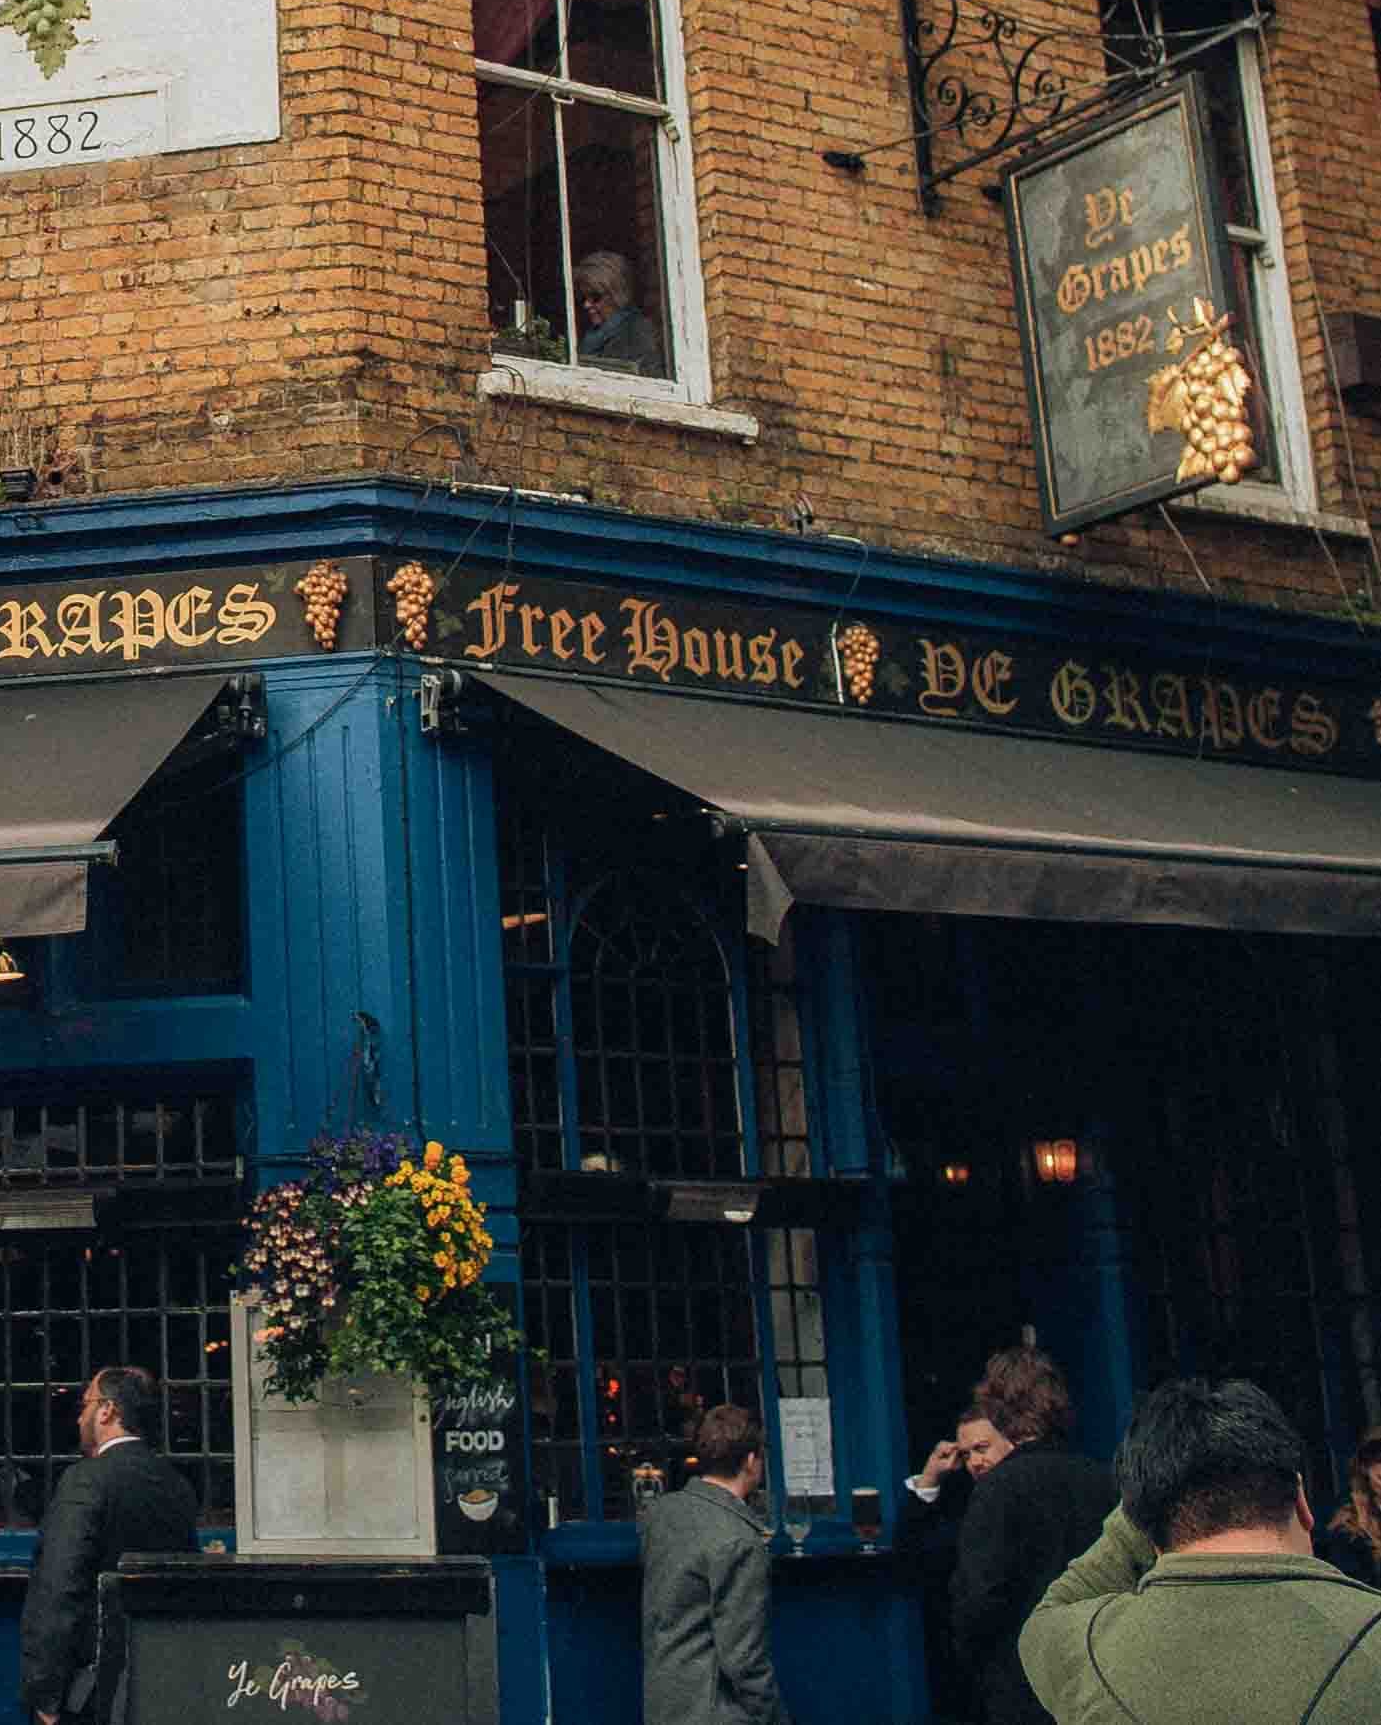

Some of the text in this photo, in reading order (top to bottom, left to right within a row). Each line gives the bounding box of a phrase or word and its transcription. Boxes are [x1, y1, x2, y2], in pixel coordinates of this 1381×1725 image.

[1083, 186, 1134, 250] Ye
[1056, 223, 1192, 315] Grapes
[1085, 314, 1155, 372] 1882
[463, 582, 806, 690] Free House
[1050, 659, 1340, 755] GRAPES
[444, 1430, 505, 1453] FOOD
[226, 1660, 361, 1710] Ye Grapes
